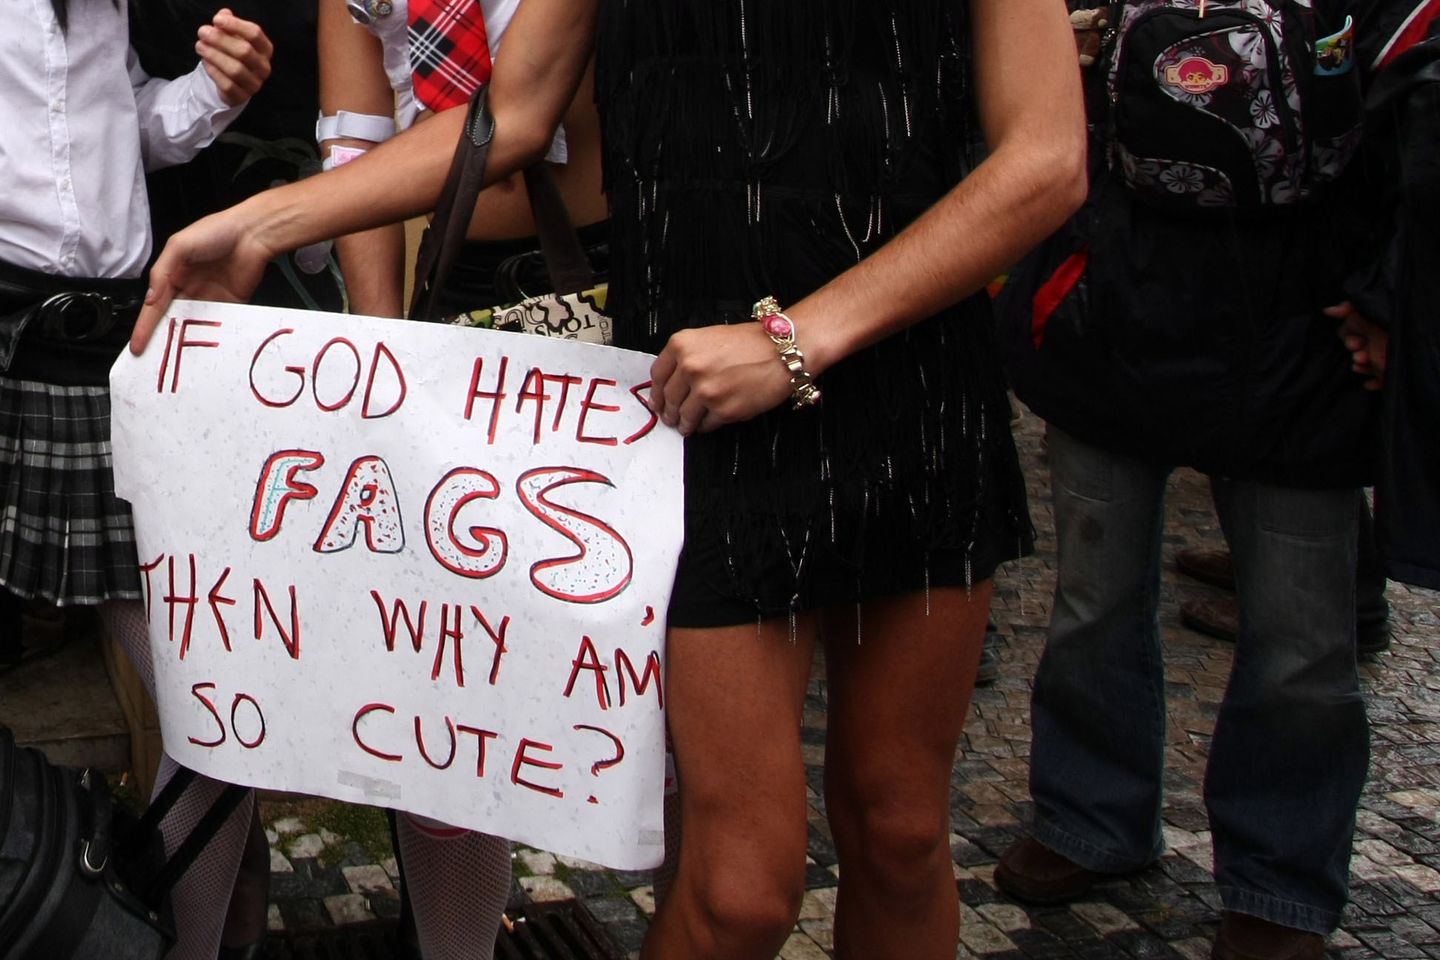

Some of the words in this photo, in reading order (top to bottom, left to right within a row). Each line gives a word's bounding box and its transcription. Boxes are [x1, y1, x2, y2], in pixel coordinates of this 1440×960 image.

[156, 317, 222, 393] IF
[249, 328, 407, 420] GOD
[464, 355, 658, 445] HATES
[139, 553, 300, 660] THEN
[371, 590, 510, 687] WHY
[562, 636, 664, 711] AM
[188, 682, 266, 749] SO
[352, 702, 626, 804] CUTE?
